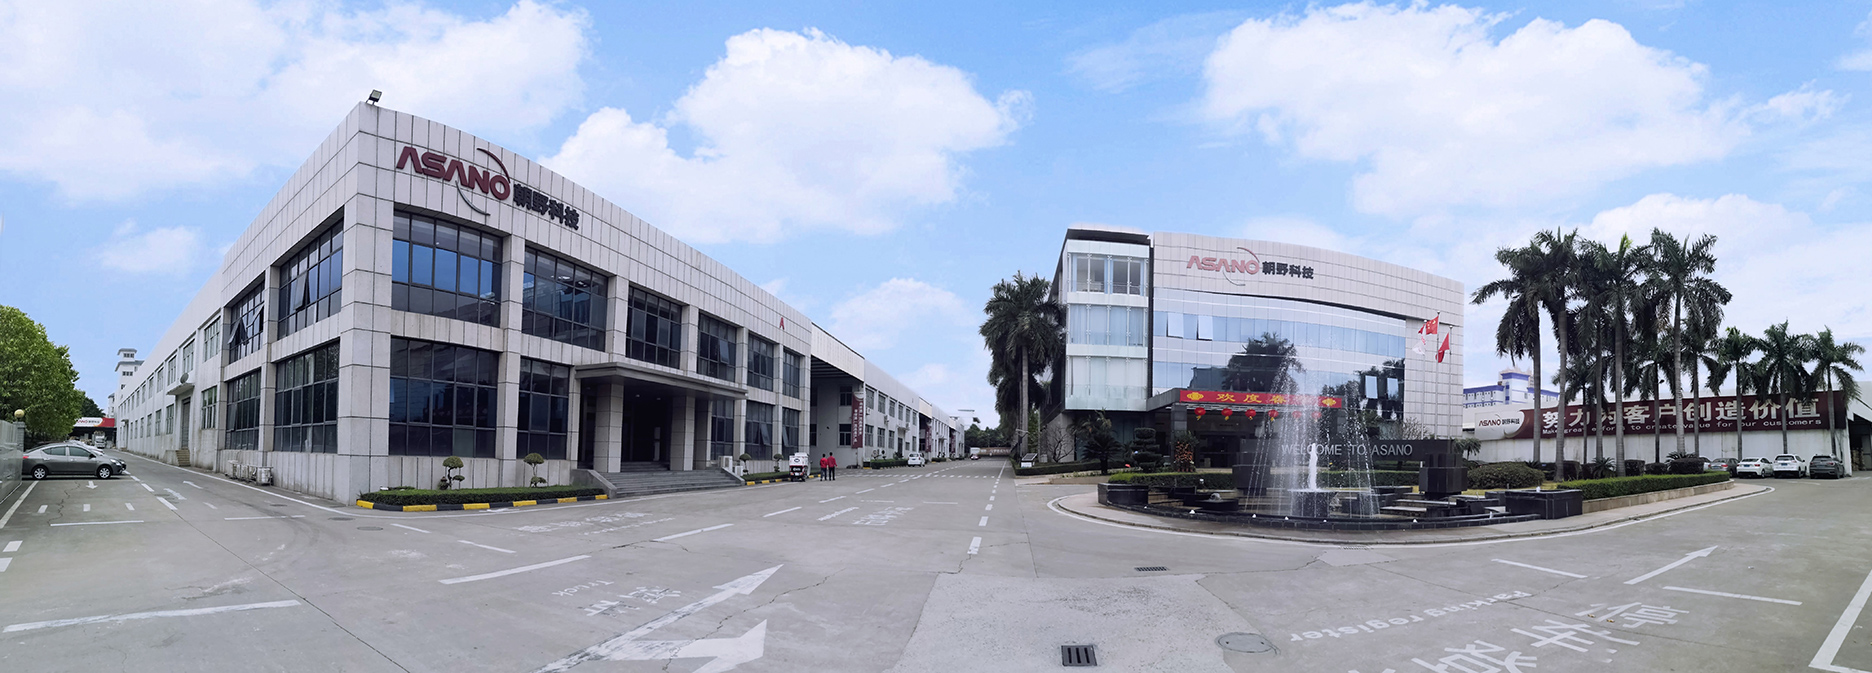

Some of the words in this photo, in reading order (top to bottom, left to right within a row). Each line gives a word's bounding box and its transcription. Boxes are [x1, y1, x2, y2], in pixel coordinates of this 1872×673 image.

[396, 146, 510, 200] ASANO
[513, 183, 579, 230] 朝野科技
[1186, 255, 1260, 275] ASANO
[1262, 260, 1314, 279] 朝野科技
[779, 316, 785, 330] A
[1217, 393, 1312, 405] 欢度春
[1479, 419, 1501, 427] ASANO
[1763, 419, 1821, 427] cusomers
[1351, 444, 1366, 455] TO
[1371, 444, 1413, 455] ASANO
[1424, 590, 1532, 618] Parking
[1290, 614, 1424, 642] register
